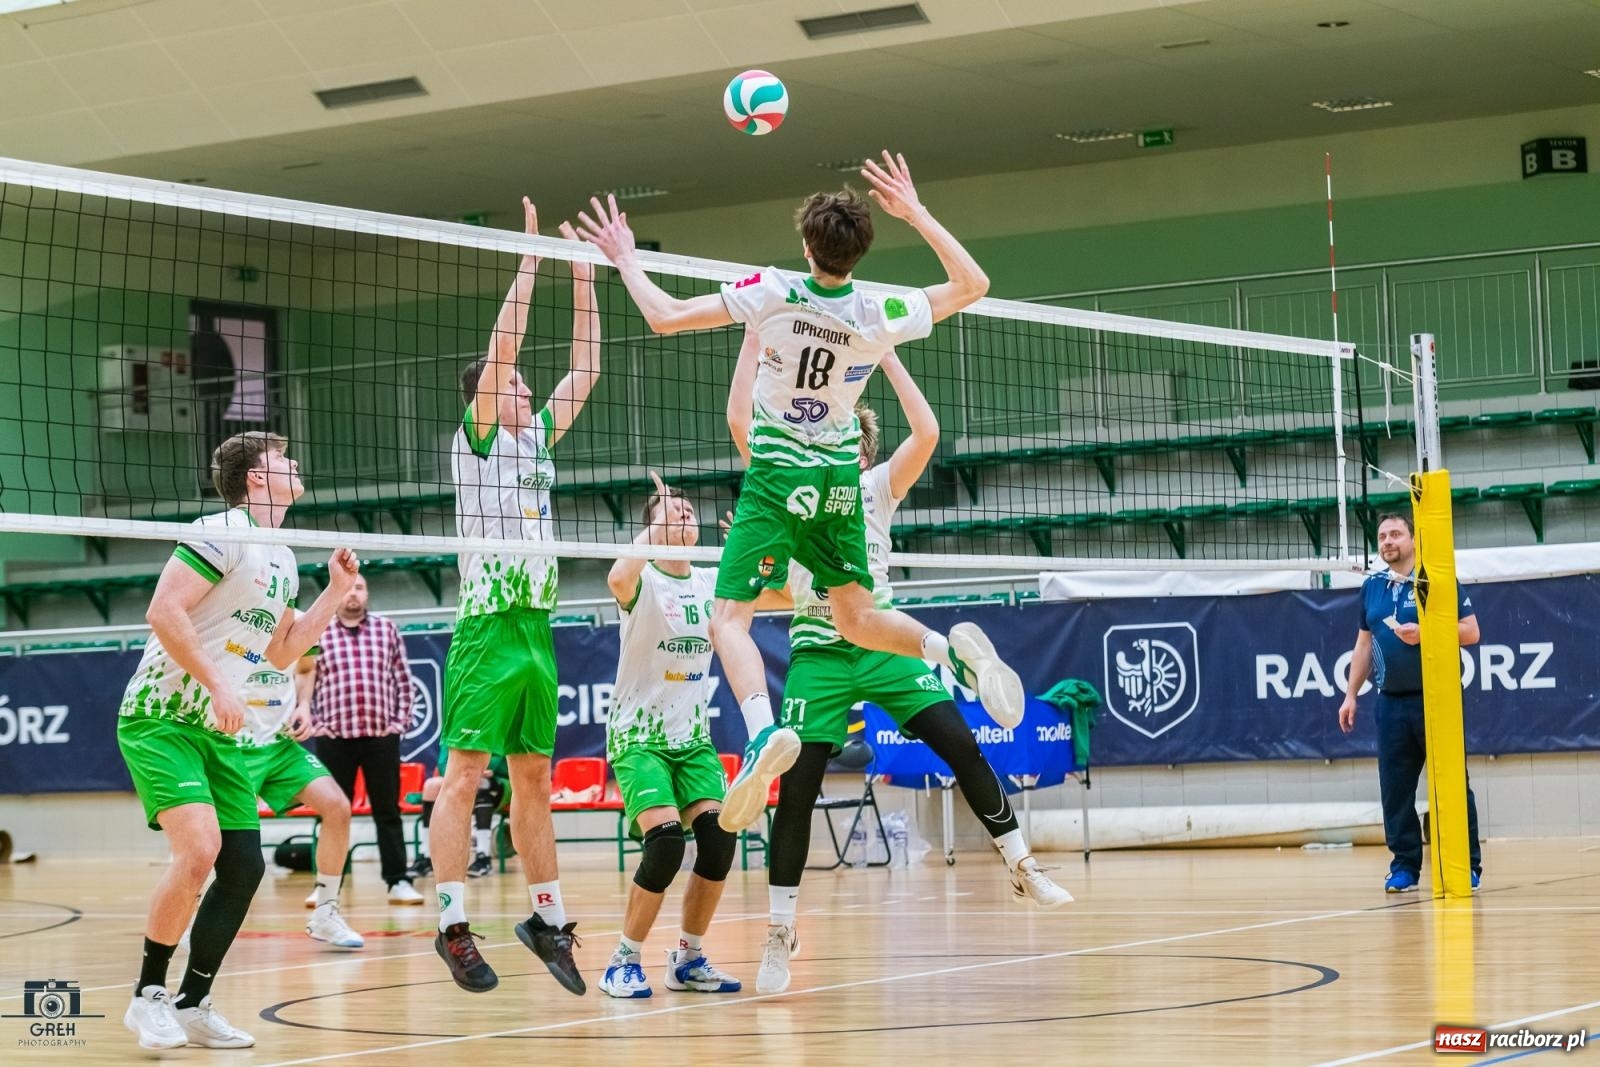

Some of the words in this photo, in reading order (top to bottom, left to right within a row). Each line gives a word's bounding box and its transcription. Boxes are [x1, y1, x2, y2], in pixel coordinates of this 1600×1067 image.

[1525, 152, 1538, 174] B
[1551, 149, 1577, 170] B
[795, 346, 836, 390] 18
[682, 604, 699, 625] 16
[1256, 641, 1555, 699] RACRZ
[784, 697, 806, 723] 37
[971, 725, 1014, 744] olten
[1036, 722, 1072, 742] molte
[537, 892, 555, 905] R
[679, 938, 689, 950] R
